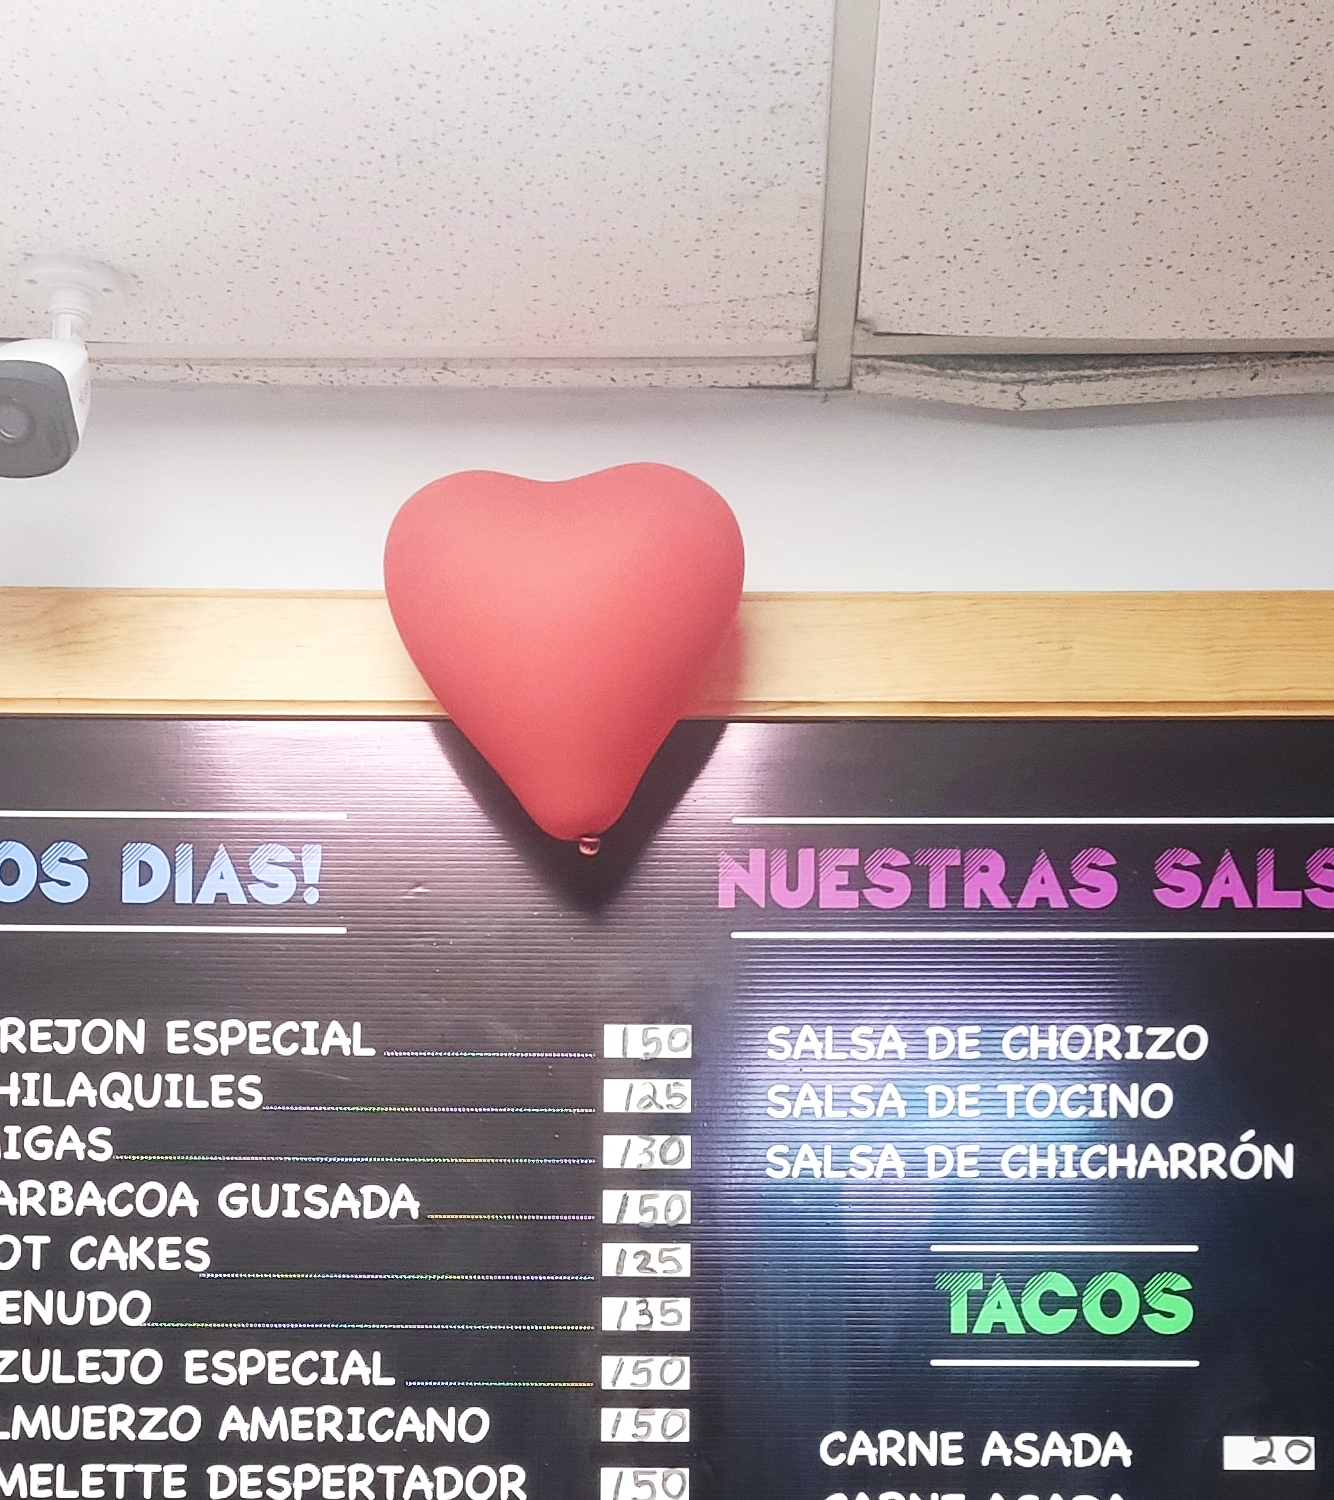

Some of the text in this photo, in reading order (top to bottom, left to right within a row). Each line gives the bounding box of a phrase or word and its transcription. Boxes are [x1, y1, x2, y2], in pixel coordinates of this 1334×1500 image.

[120, 840, 324, 905] DIAS!
[717, 846, 1119, 910] NUESTRAS
[166, 1019, 376, 1056] ESPECIAL
[622, 1027, 691, 1059] 150
[766, 1024, 1209, 1061] SALSA DE CHORIZO
[624, 1082, 687, 1112] 125
[766, 1082, 1174, 1120] SALSA DE TOCINO
[620, 1135, 685, 1168] 130
[765, 1132, 1295, 1180] SALSA DE CHICHARRÓN
[218, 1183, 420, 1219] GUISADA
[616, 1192, 687, 1227] 150
[70, 1235, 210, 1272] CAKES
[615, 1246, 682, 1275] 125
[617, 1298, 682, 1331] 135
[935, 1271, 1194, 1336] TACOS
[184, 1349, 395, 1386] ESPECIAL
[611, 1358, 685, 1387] 150
[219, 1405, 489, 1443] AMERICANO
[611, 1409, 687, 1440] 150
[820, 1430, 1132, 1467] CARNE ASADA
[1252, 1436, 1312, 1465] 20
[206, 1463, 527, 1500] DESPERTADOR
